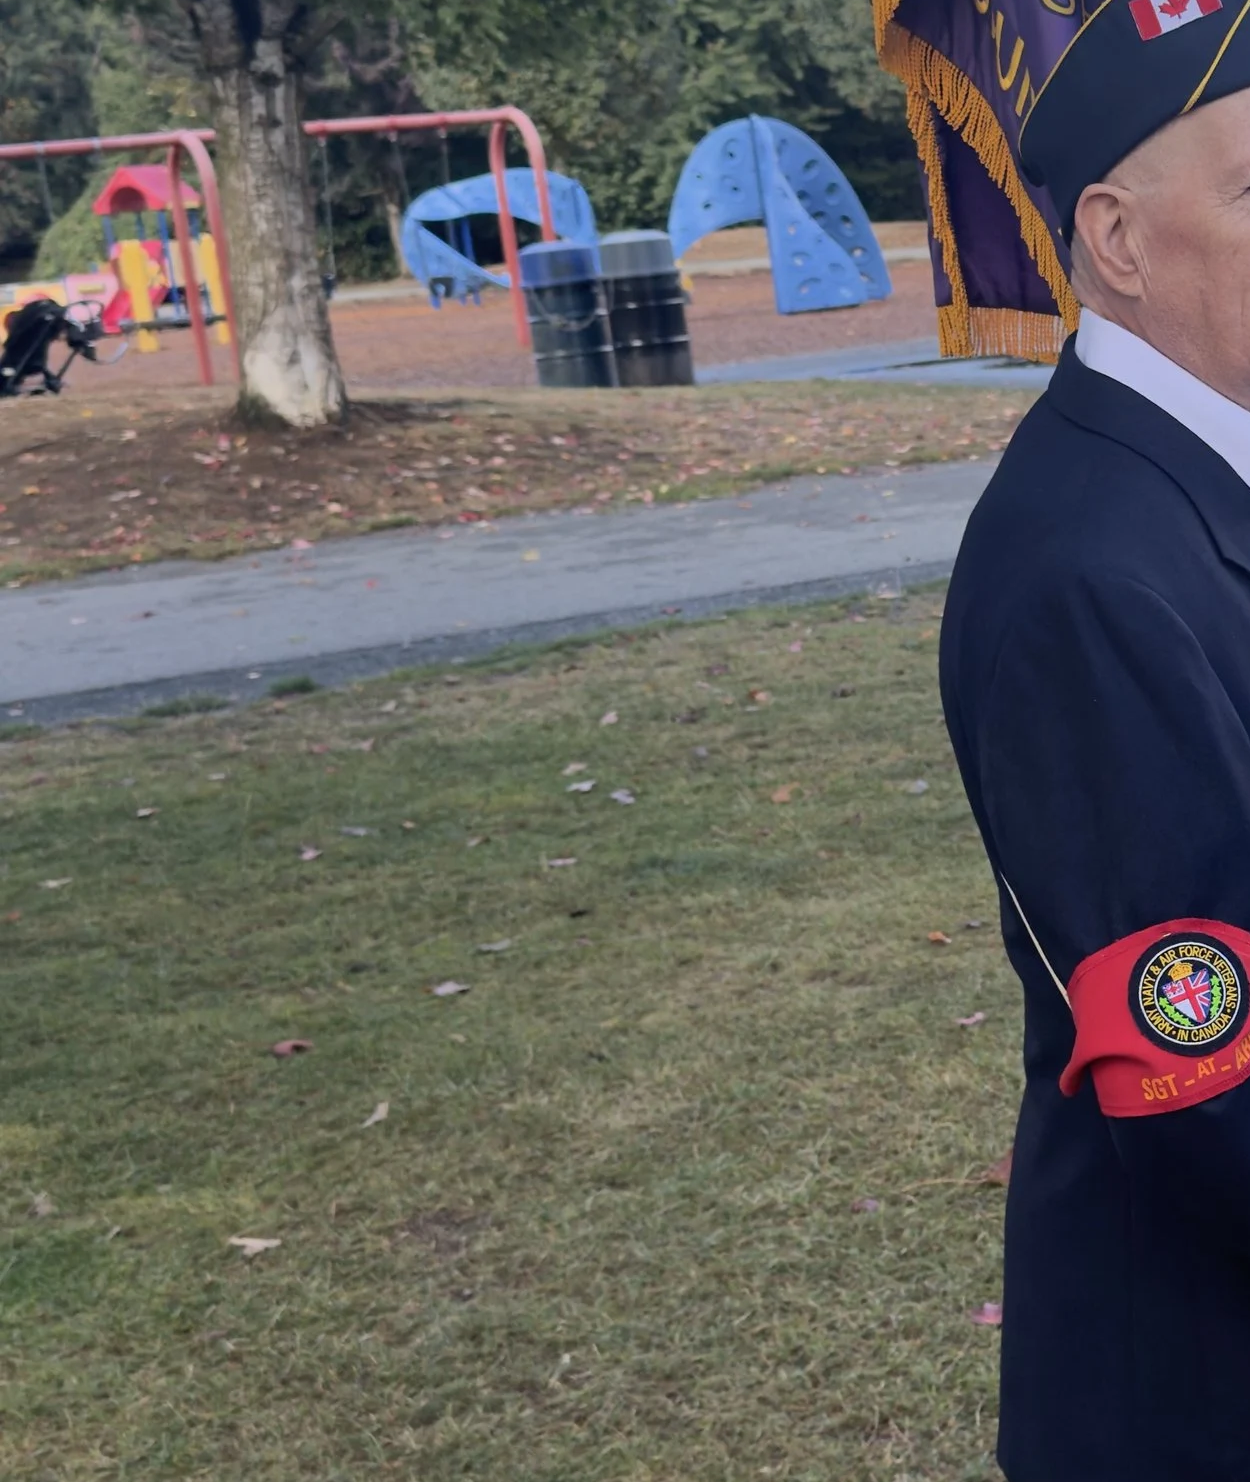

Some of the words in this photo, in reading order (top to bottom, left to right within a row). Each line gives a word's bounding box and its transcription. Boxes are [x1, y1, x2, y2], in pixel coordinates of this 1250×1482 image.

[1159, 949, 1178, 967] AIR
[1178, 945, 1214, 962] FORCE
[1150, 965, 1161, 975] &
[1213, 955, 1238, 1009] VETERANS
[1142, 974, 1156, 1006] NAVY
[1146, 1008, 1175, 1035] ARMY
[1176, 1029, 1189, 1042] IN
[1191, 1013, 1232, 1042] CANADA
[1141, 1073, 1179, 1101] SGT
[1197, 1057, 1217, 1079] AT
